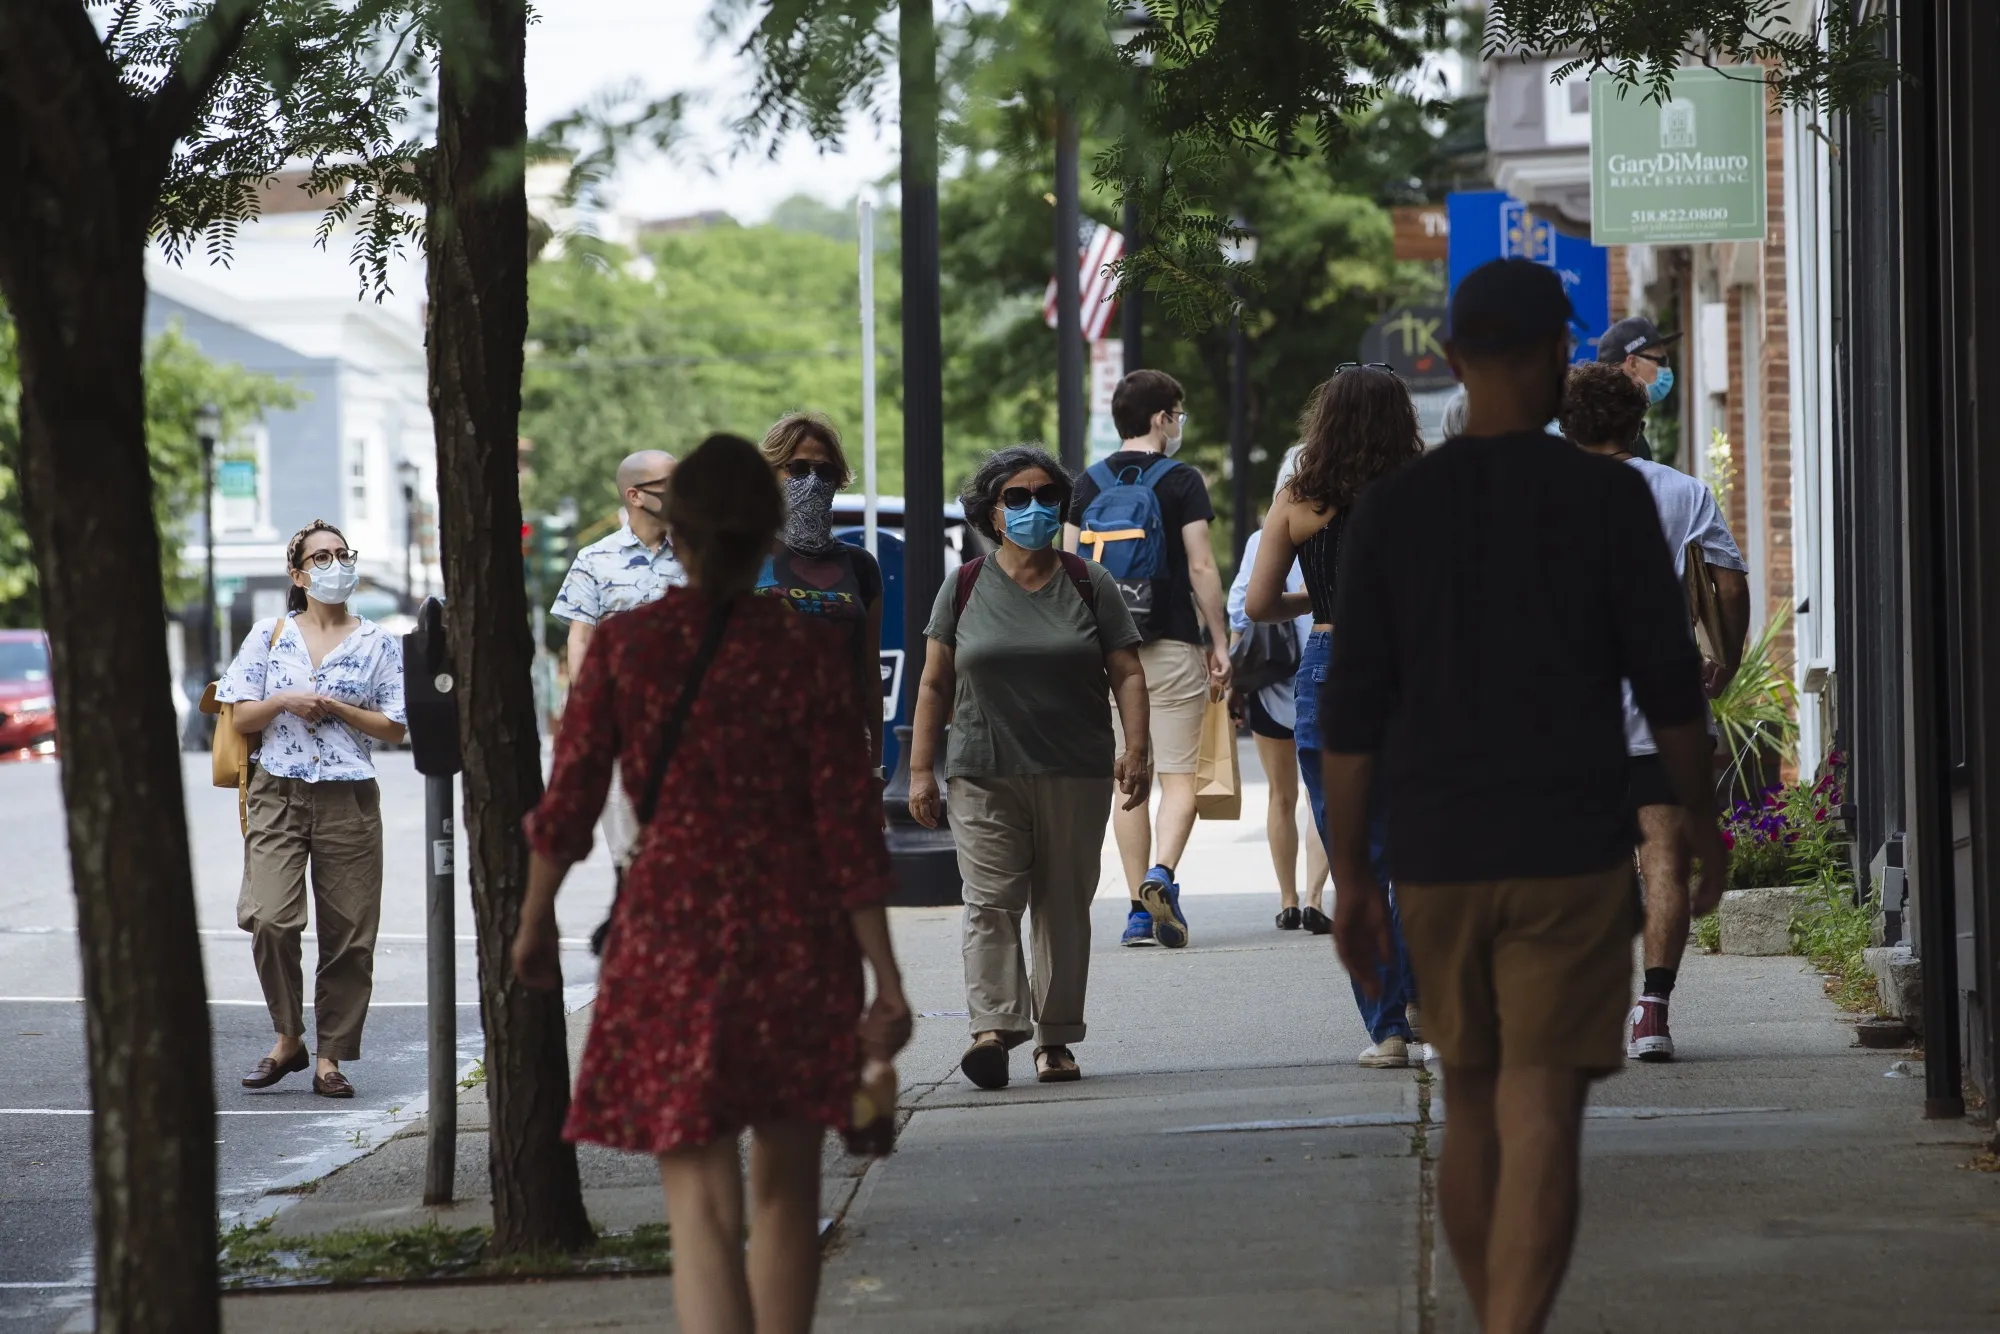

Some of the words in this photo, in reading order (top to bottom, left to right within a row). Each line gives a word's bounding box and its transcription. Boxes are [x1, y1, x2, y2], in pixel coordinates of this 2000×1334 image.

[1608, 151, 1748, 178] GaryDiMauro
[1610, 176, 1651, 188] REAL
[1655, 174, 1715, 186] ESTATE
[1631, 207, 1728, 223] 518.822.0800
